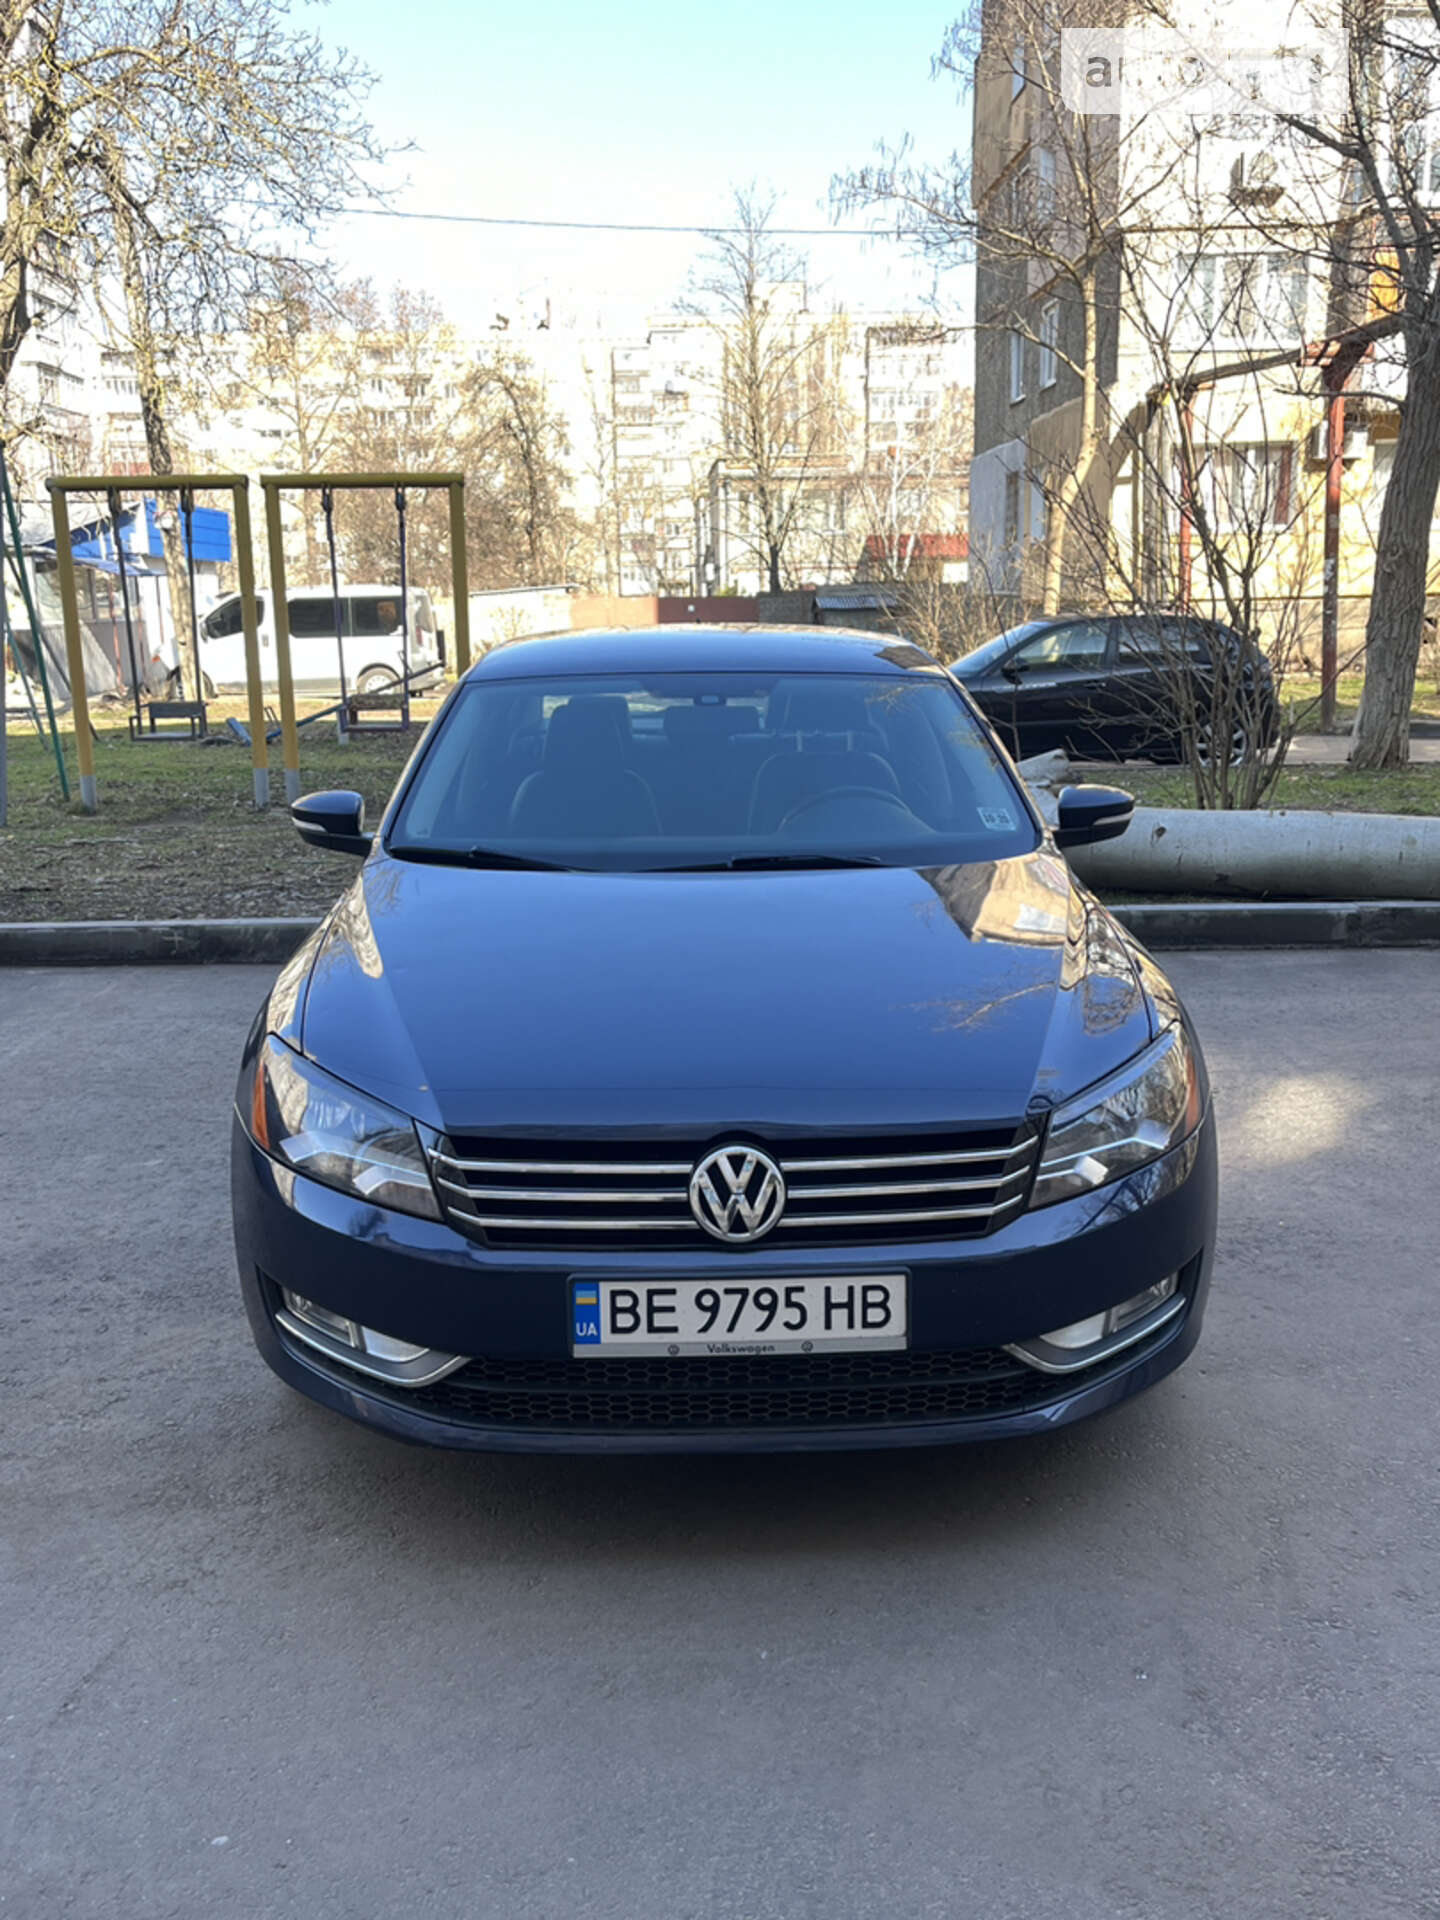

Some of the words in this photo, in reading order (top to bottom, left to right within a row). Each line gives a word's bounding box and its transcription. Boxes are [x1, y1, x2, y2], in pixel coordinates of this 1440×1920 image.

[609, 1288, 679, 1335] BE
[694, 1286, 808, 1334] 9795
[824, 1284, 893, 1331] HB
[575, 1323, 598, 1337] UA
[706, 1343, 776, 1355] Volkswagen
